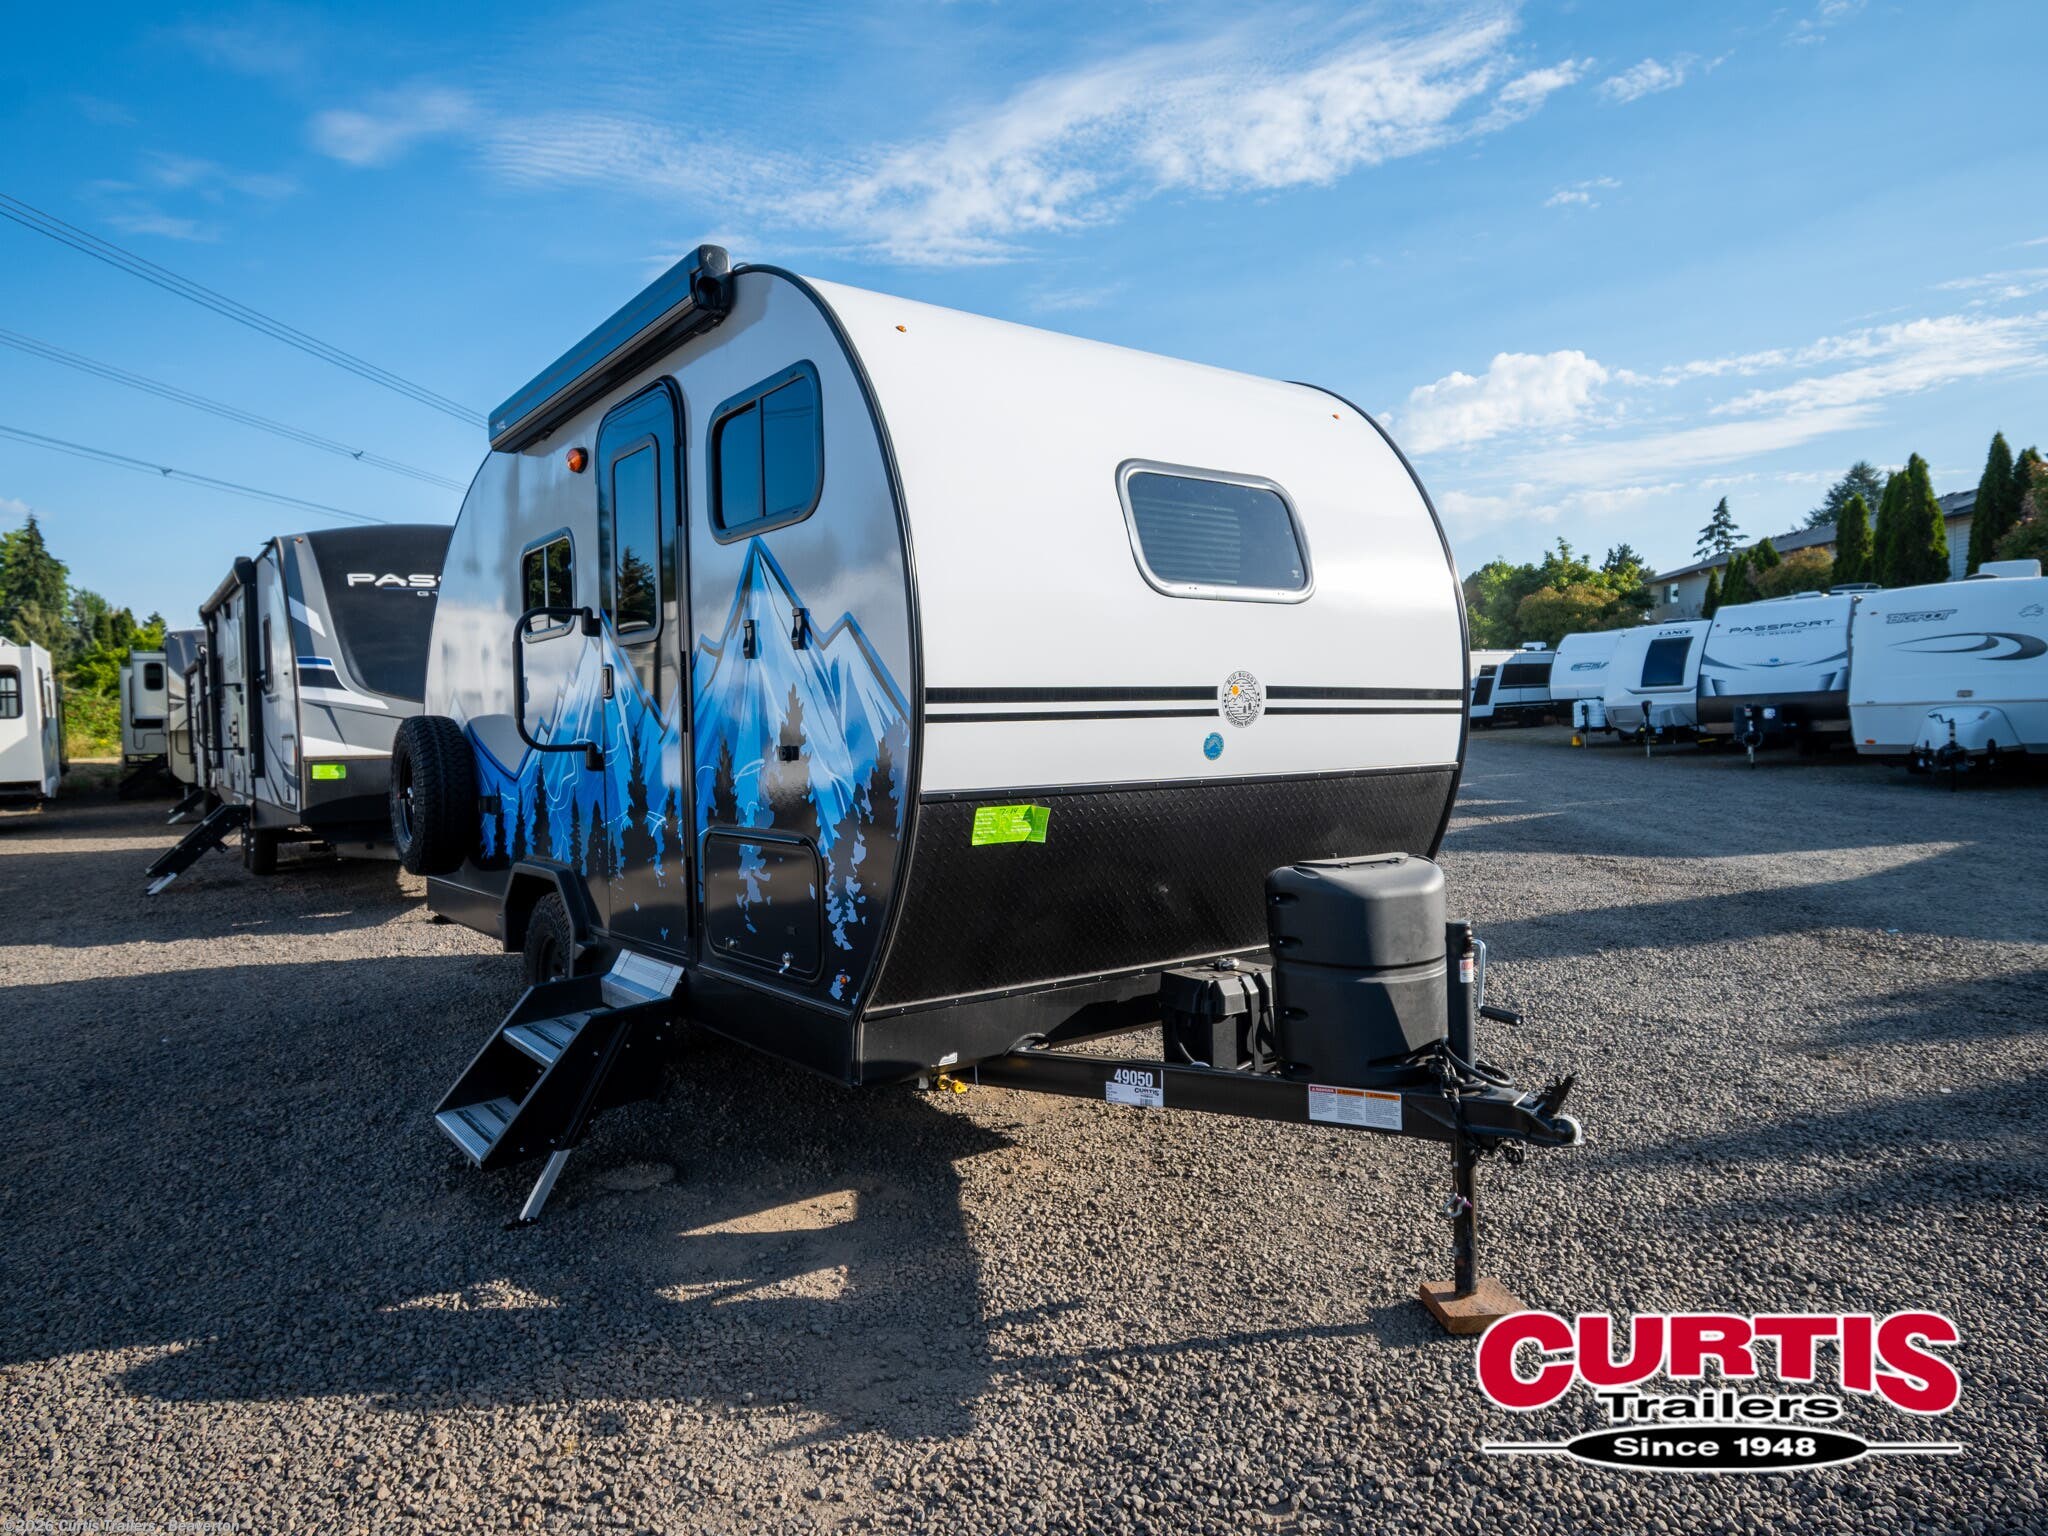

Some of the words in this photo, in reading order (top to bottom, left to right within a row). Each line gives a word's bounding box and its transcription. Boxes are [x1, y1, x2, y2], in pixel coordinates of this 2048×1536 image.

[347, 573, 441, 587] PAS
[1886, 609, 1958, 624] BIGFOOT
[1729, 619, 1834, 633] PASSPORT
[1227, 673, 1237, 685] BIG
[1114, 1069, 1153, 1088] 49050
[1134, 1087, 1160, 1097] CURTIS
